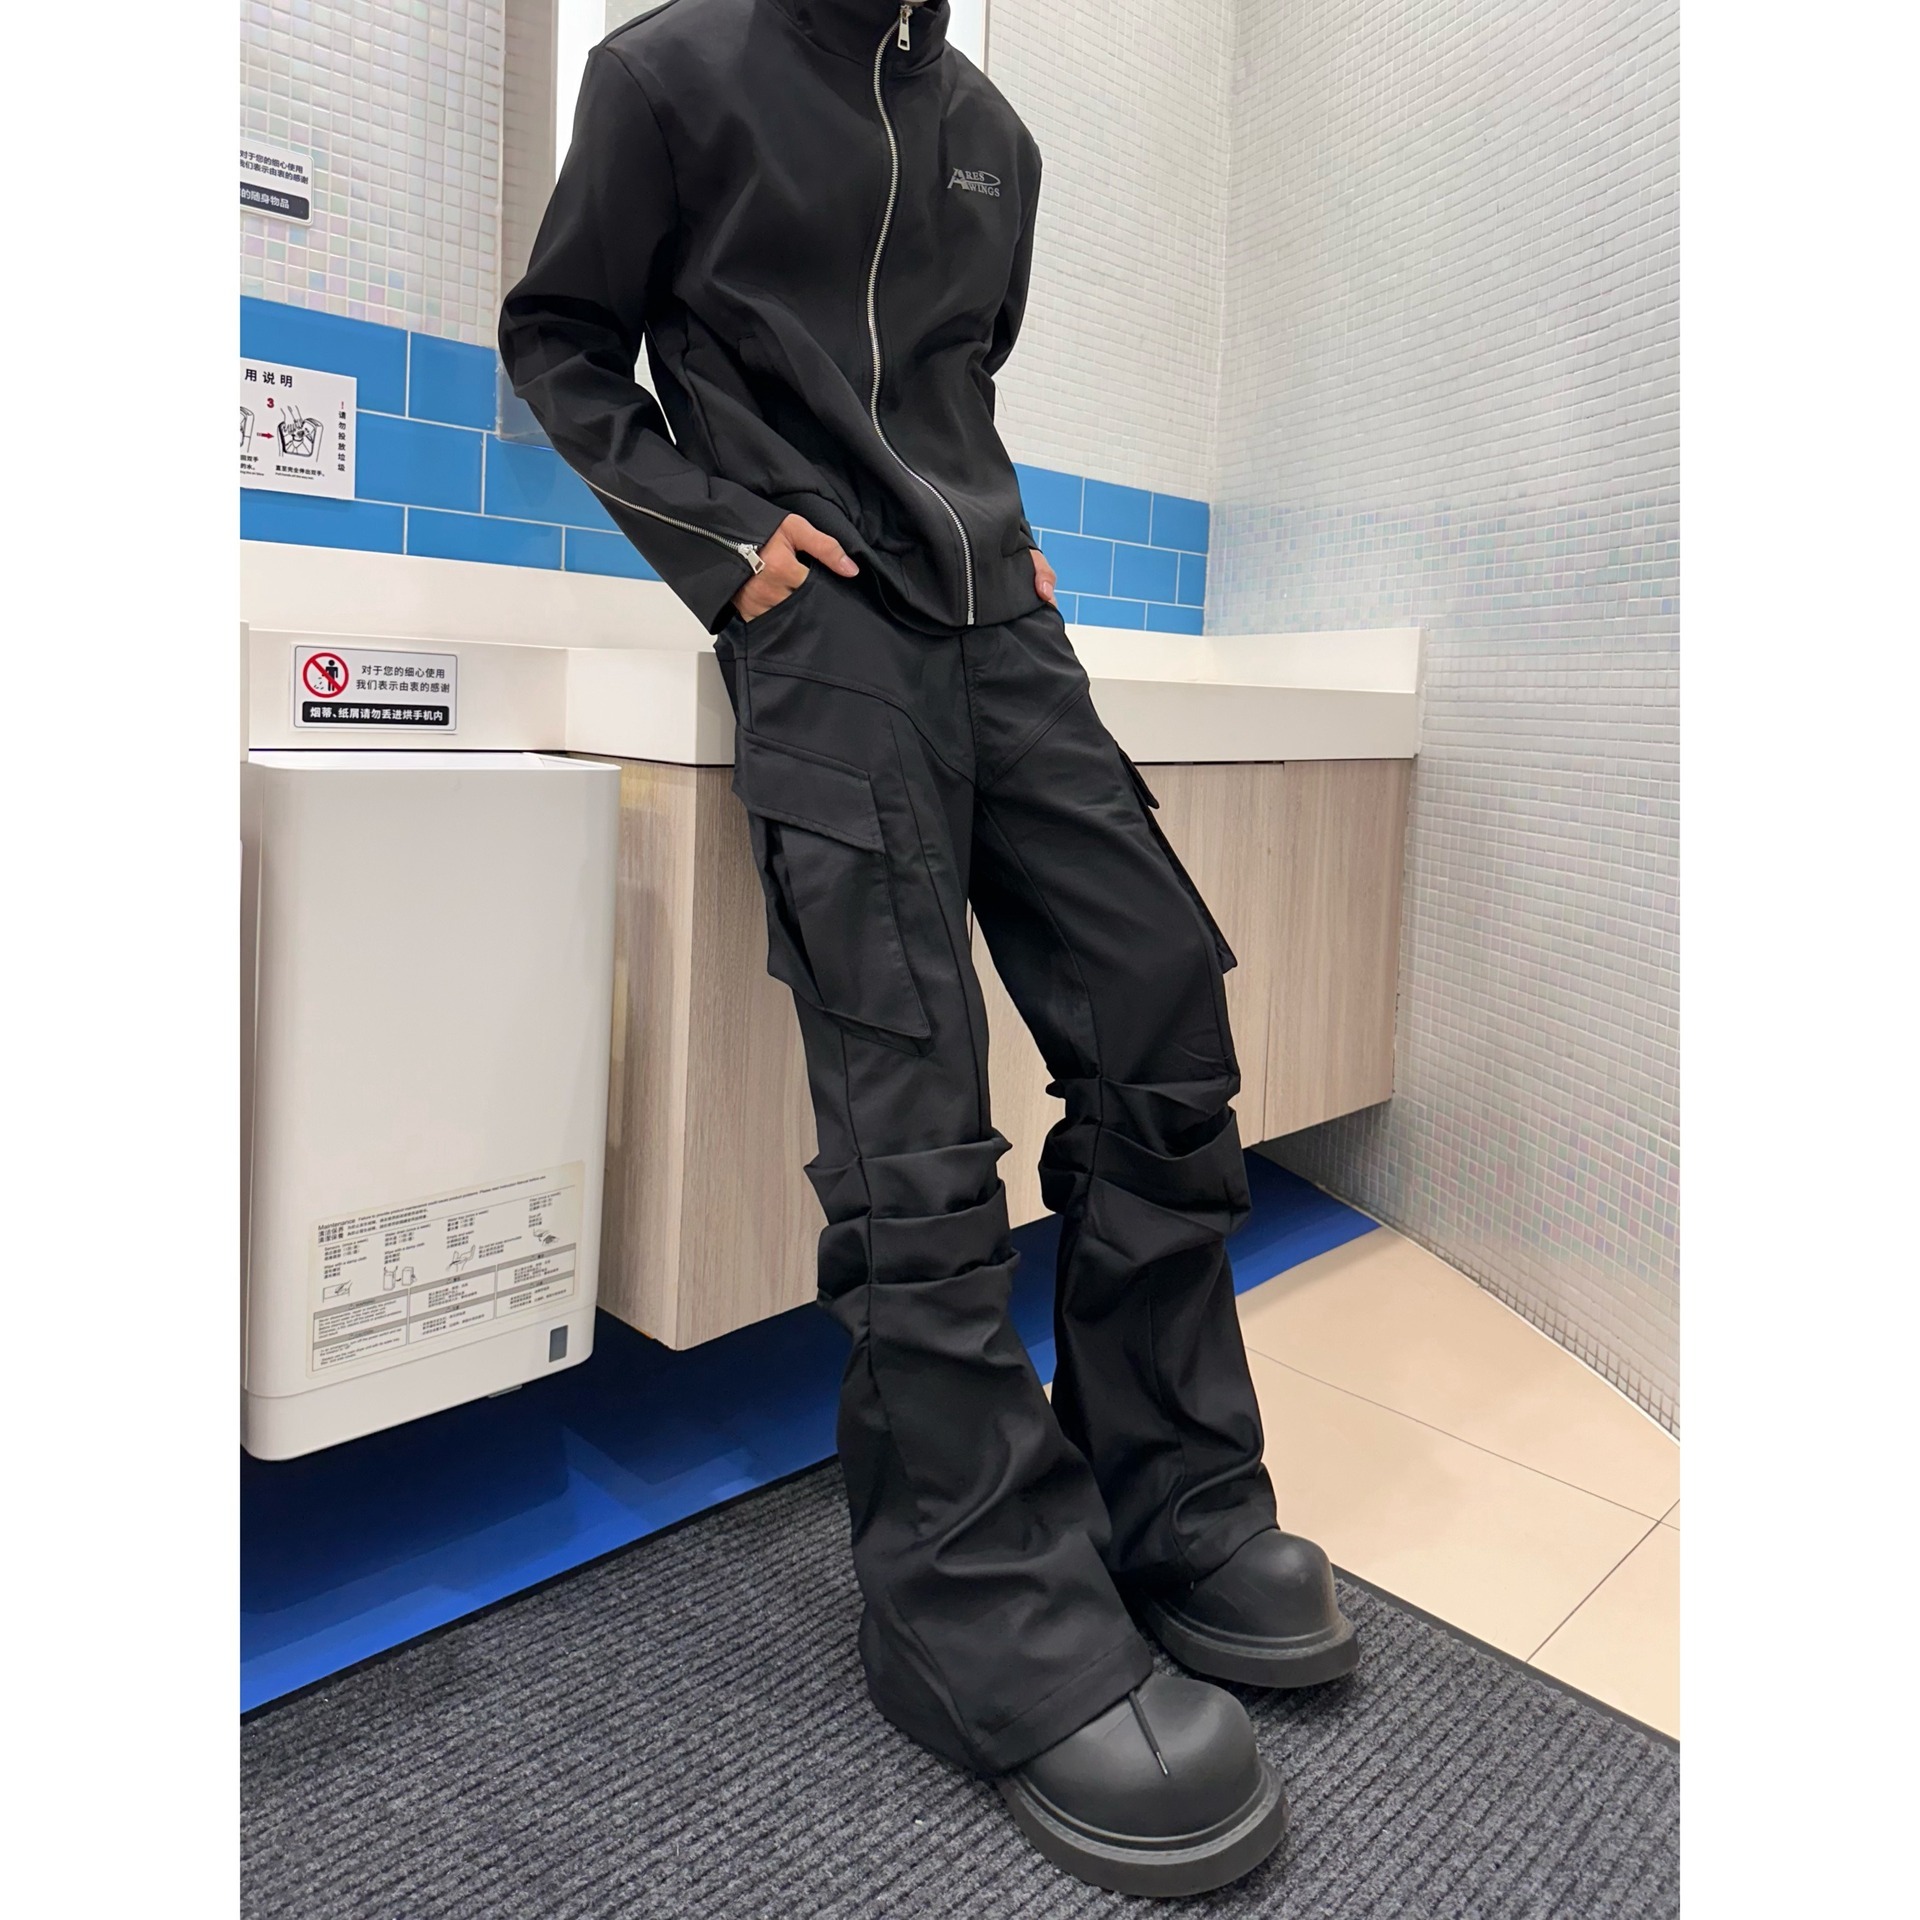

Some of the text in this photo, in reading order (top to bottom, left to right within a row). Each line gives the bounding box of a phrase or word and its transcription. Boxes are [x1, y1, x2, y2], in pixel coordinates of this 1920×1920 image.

[968, 182, 1000, 197] WINGS
[244, 368, 293, 388] 用说明
[266, 397, 275, 409] 3
[361, 665, 446, 679] 对于您的细心使用
[356, 679, 450, 694] 我们表示由衷的感谢
[309, 706, 443, 721] 烟蒂、纸屑请勿丢进烘手机内
[318, 1219, 356, 1230] Maintenance
